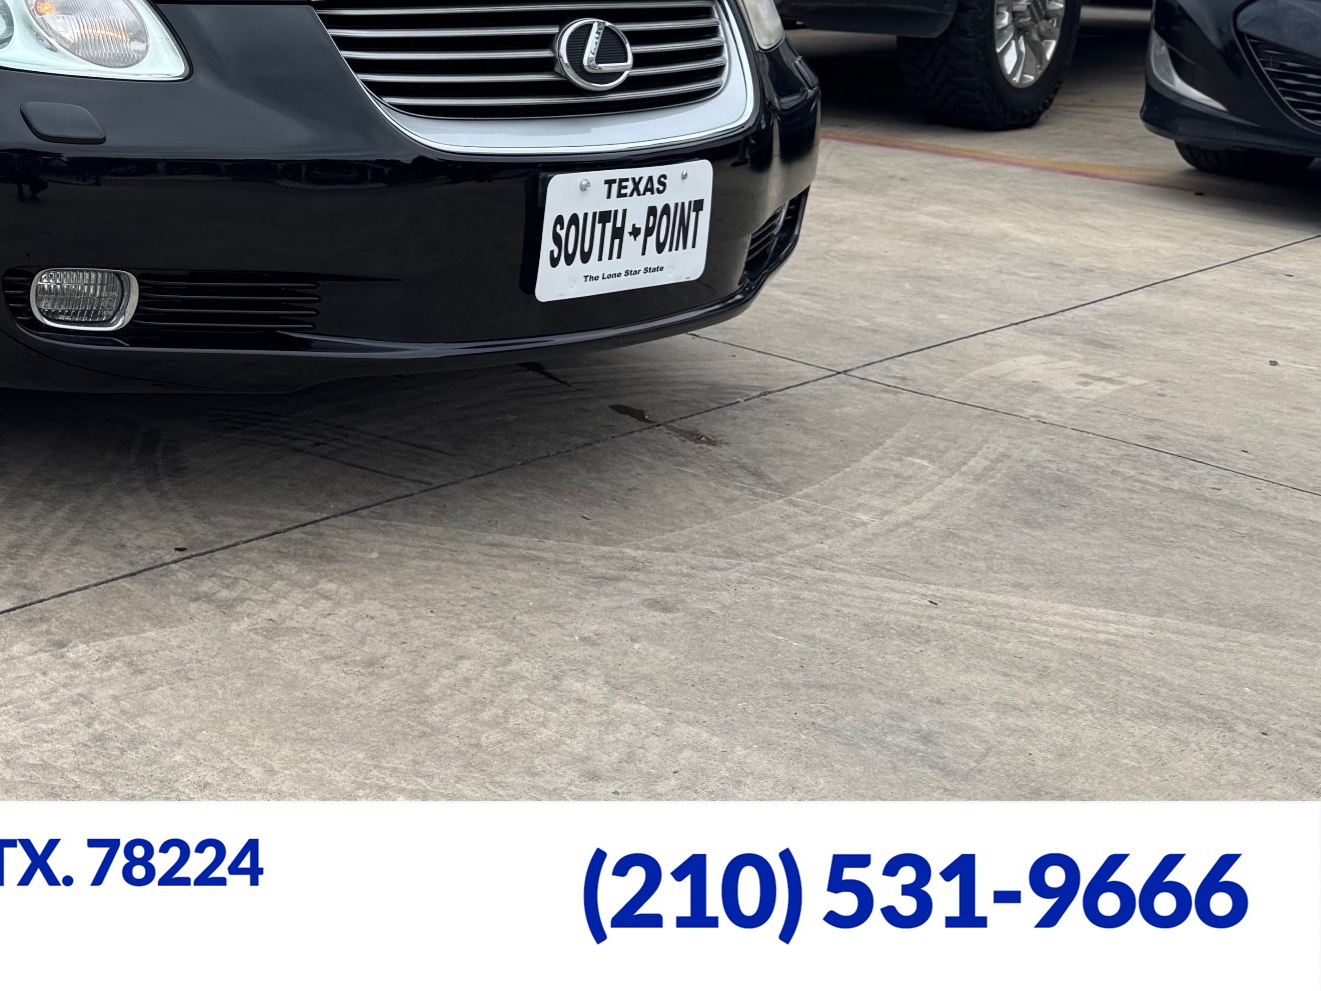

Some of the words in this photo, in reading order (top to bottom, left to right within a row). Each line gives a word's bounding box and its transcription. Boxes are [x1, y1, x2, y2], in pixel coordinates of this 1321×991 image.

[603, 173, 668, 200] TEXAS
[549, 208, 628, 269] SOUTH
[640, 198, 705, 257] POINT
[582, 274, 600, 283] The
[601, 270, 622, 281] Lone
[624, 268, 642, 278] Star
[642, 265, 665, 275] State
